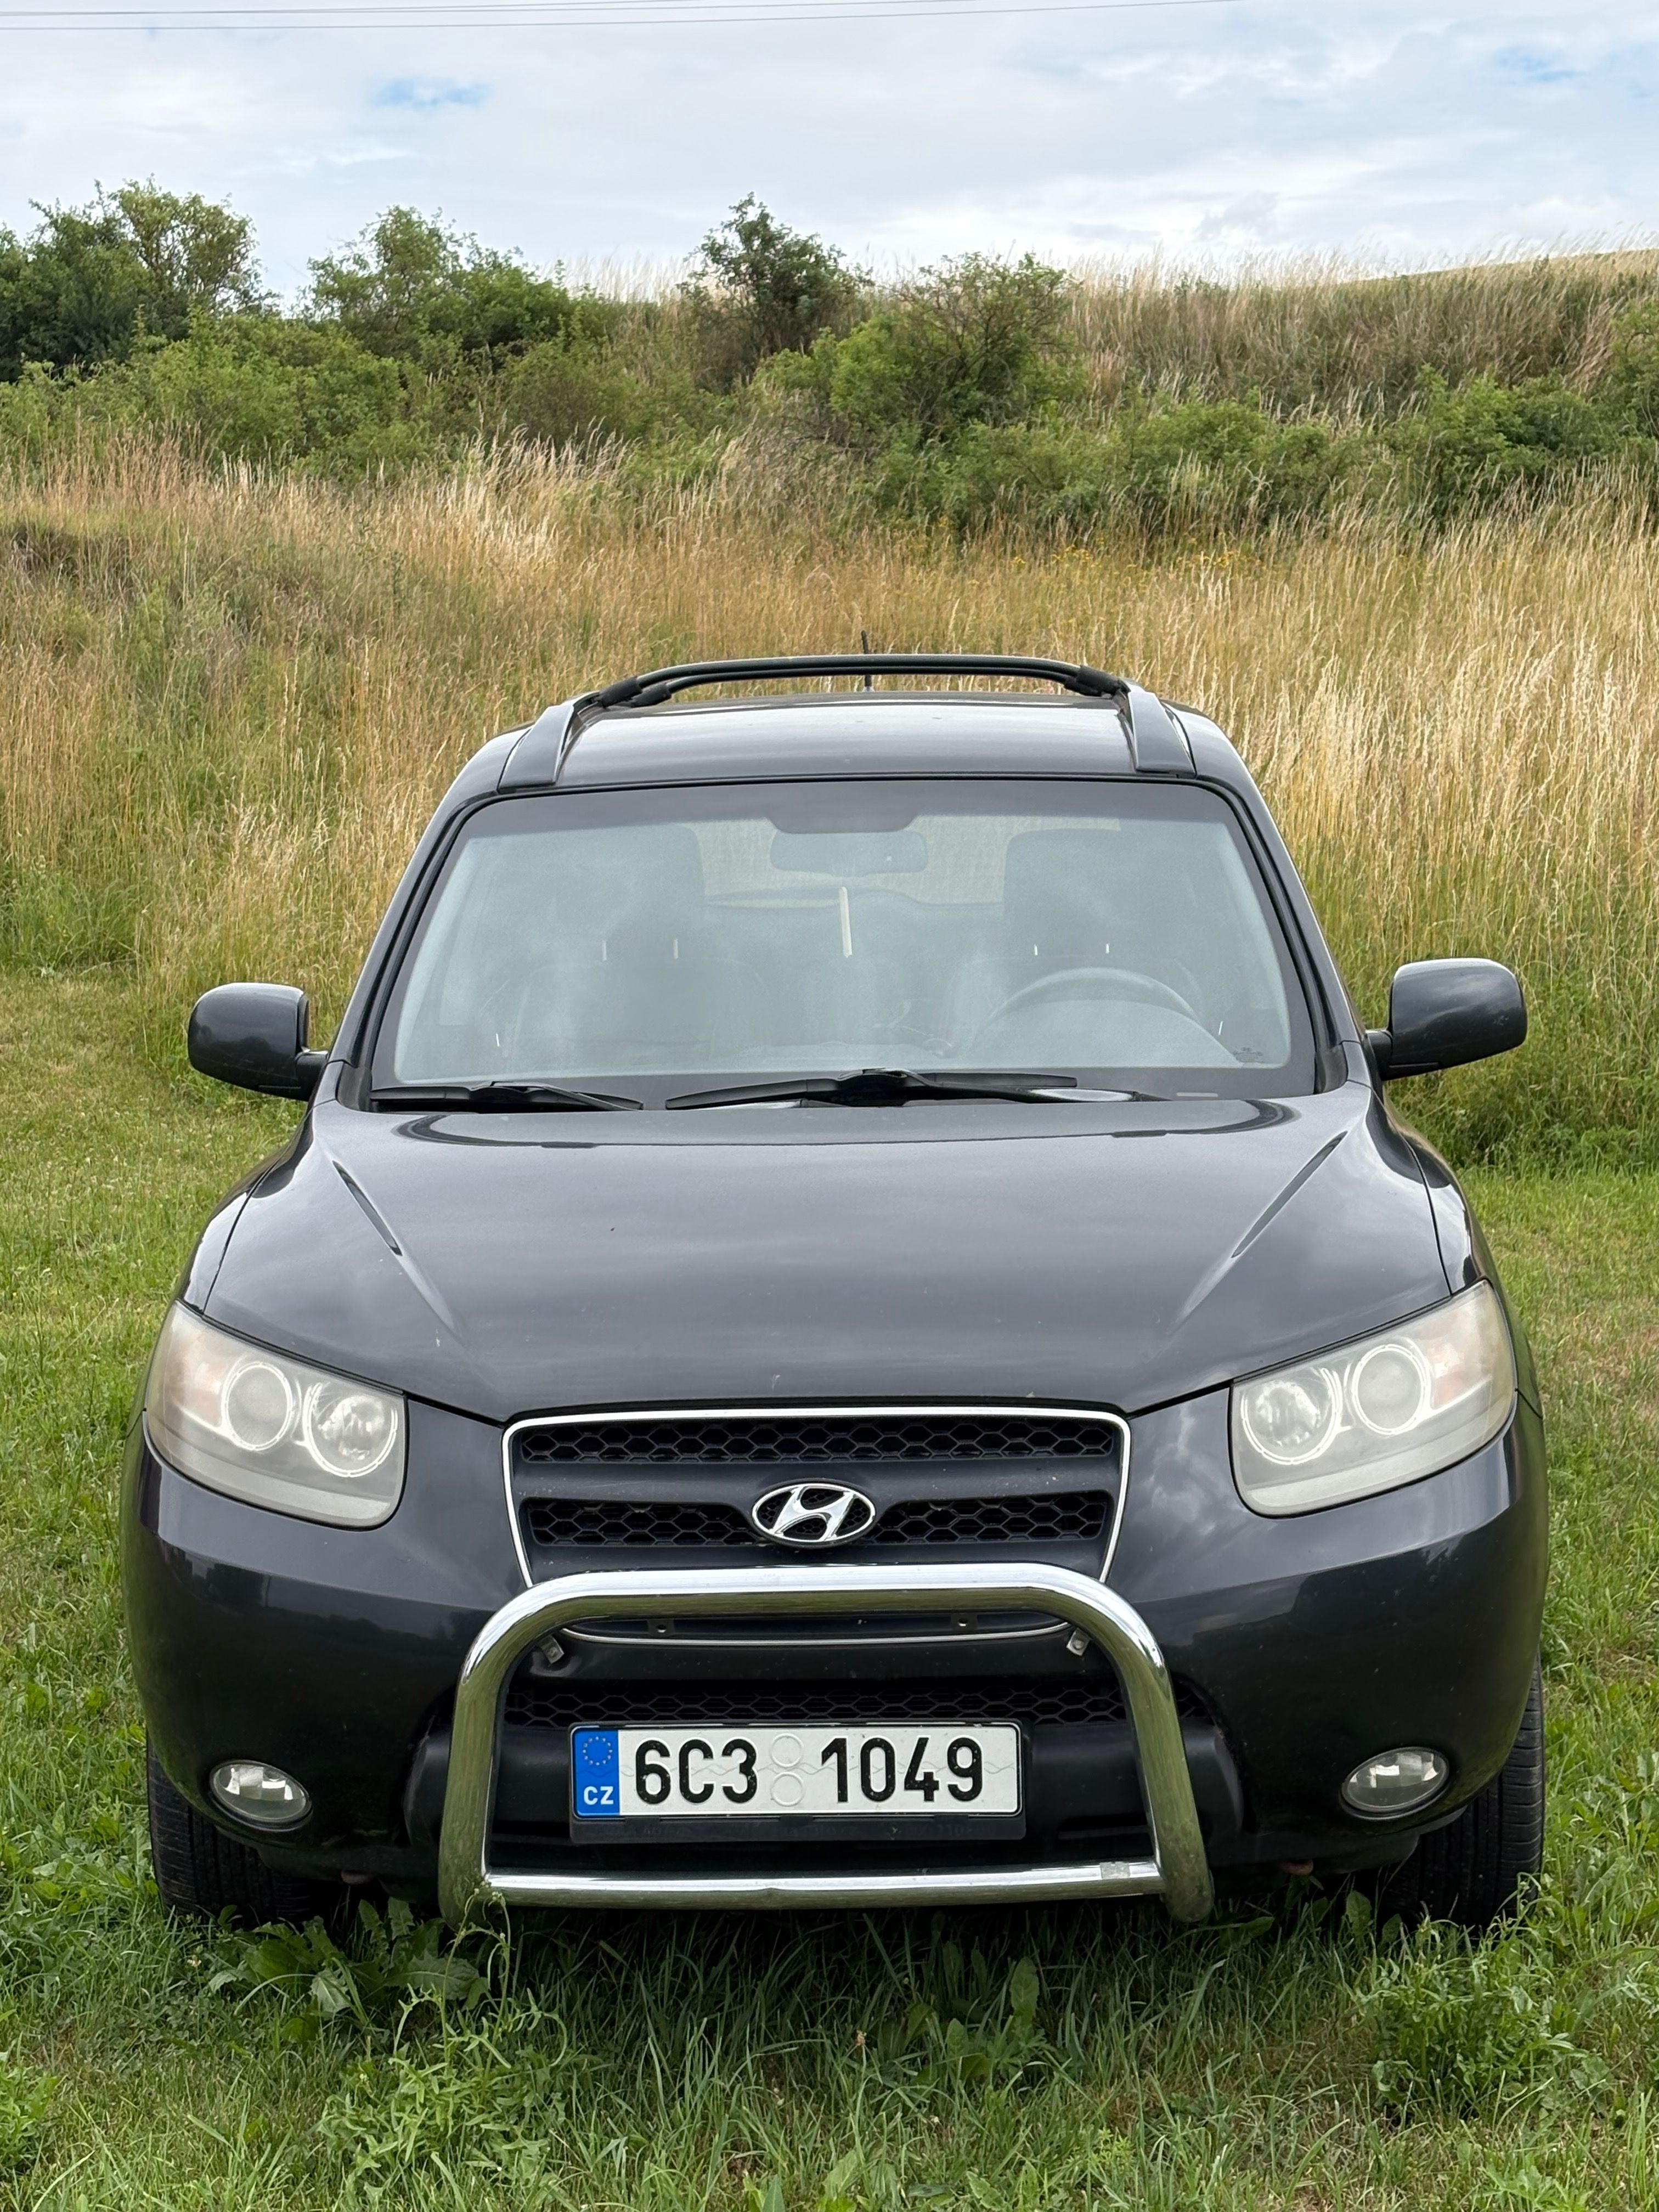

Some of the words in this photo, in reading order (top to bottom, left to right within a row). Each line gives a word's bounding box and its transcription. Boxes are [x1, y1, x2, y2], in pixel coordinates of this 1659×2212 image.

[635, 1738, 758, 1804] 6C3
[821, 1737, 983, 1803] 1049
[584, 1786, 614, 1805] CZ
